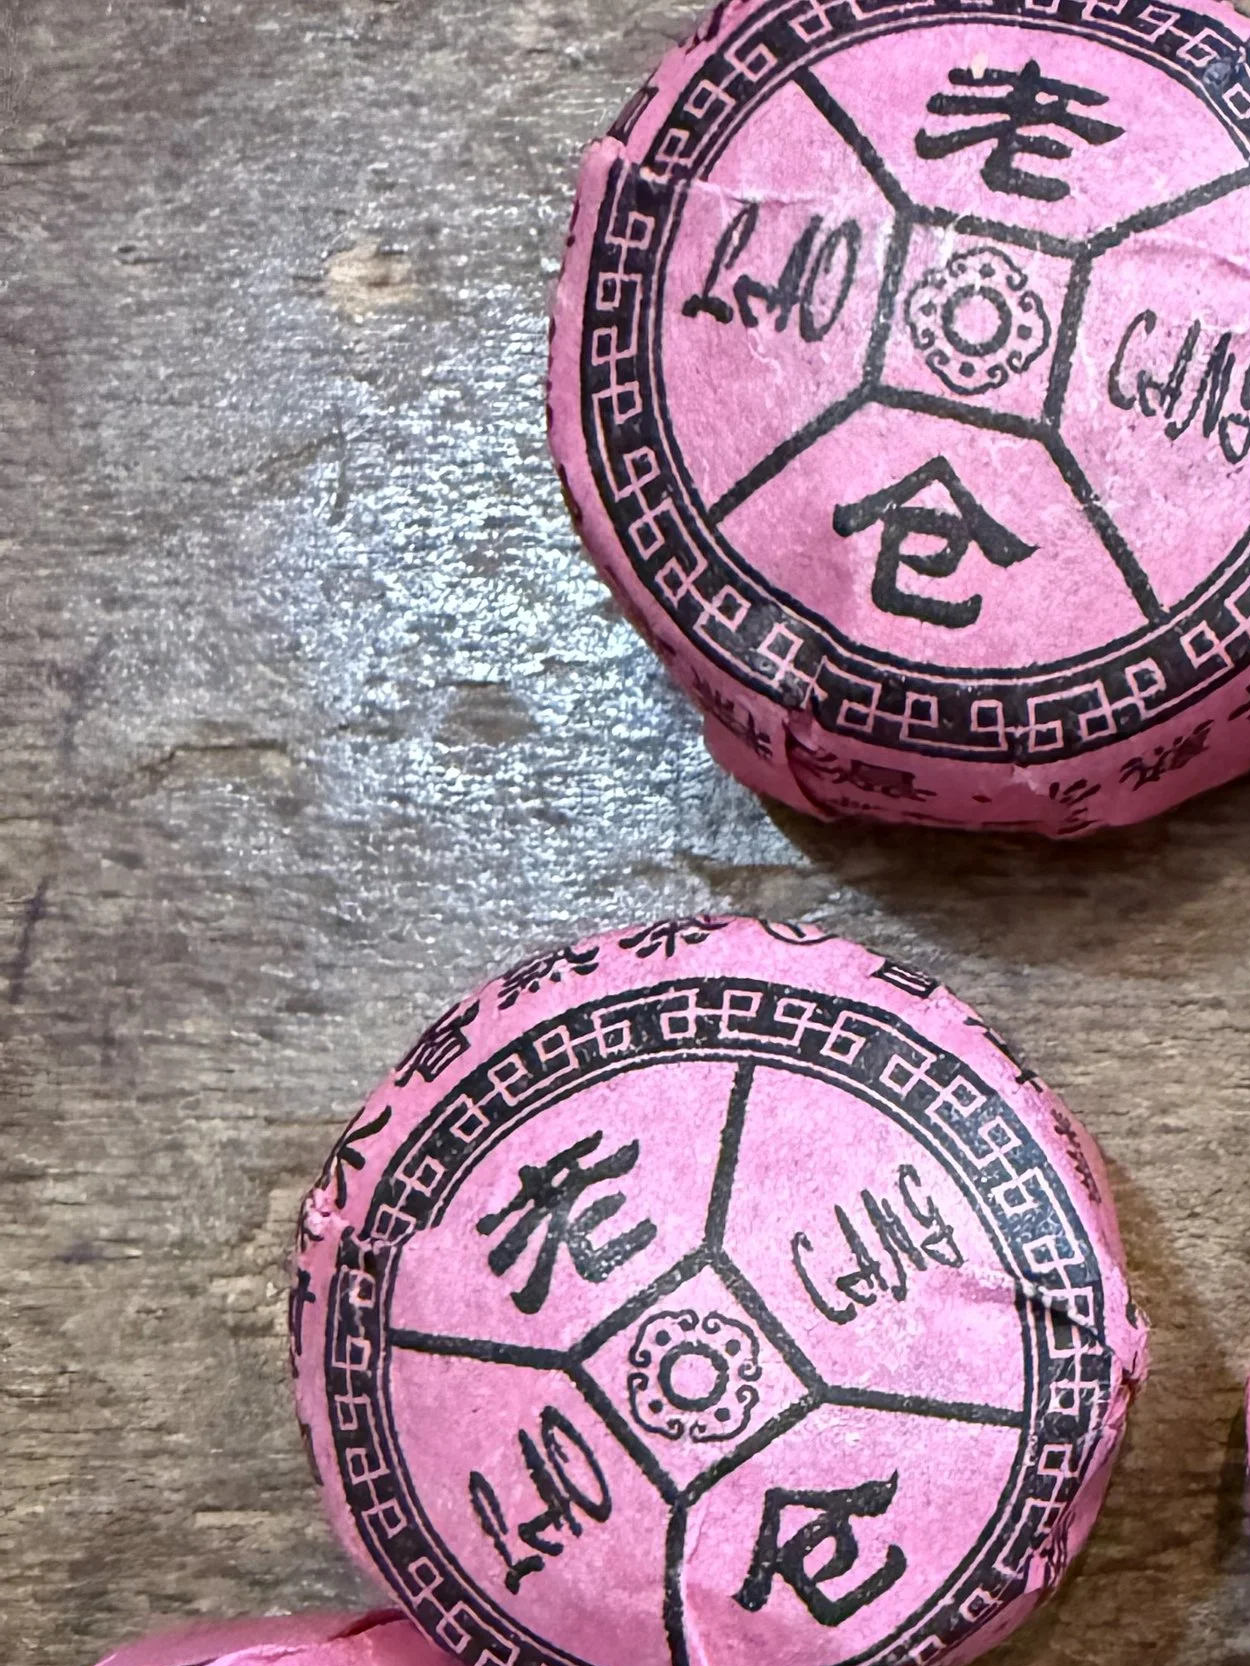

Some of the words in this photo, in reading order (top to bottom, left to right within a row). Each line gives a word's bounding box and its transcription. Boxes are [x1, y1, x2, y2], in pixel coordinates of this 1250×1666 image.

[914, 61, 1126, 200] 老
[682, 203, 862, 343] LAO
[832, 455, 1040, 630] 仓
[476, 1128, 658, 1315] 老
[790, 1164, 972, 1326] CANG
[468, 1405, 614, 1595] LAO
[731, 1469, 909, 1628] 仓
